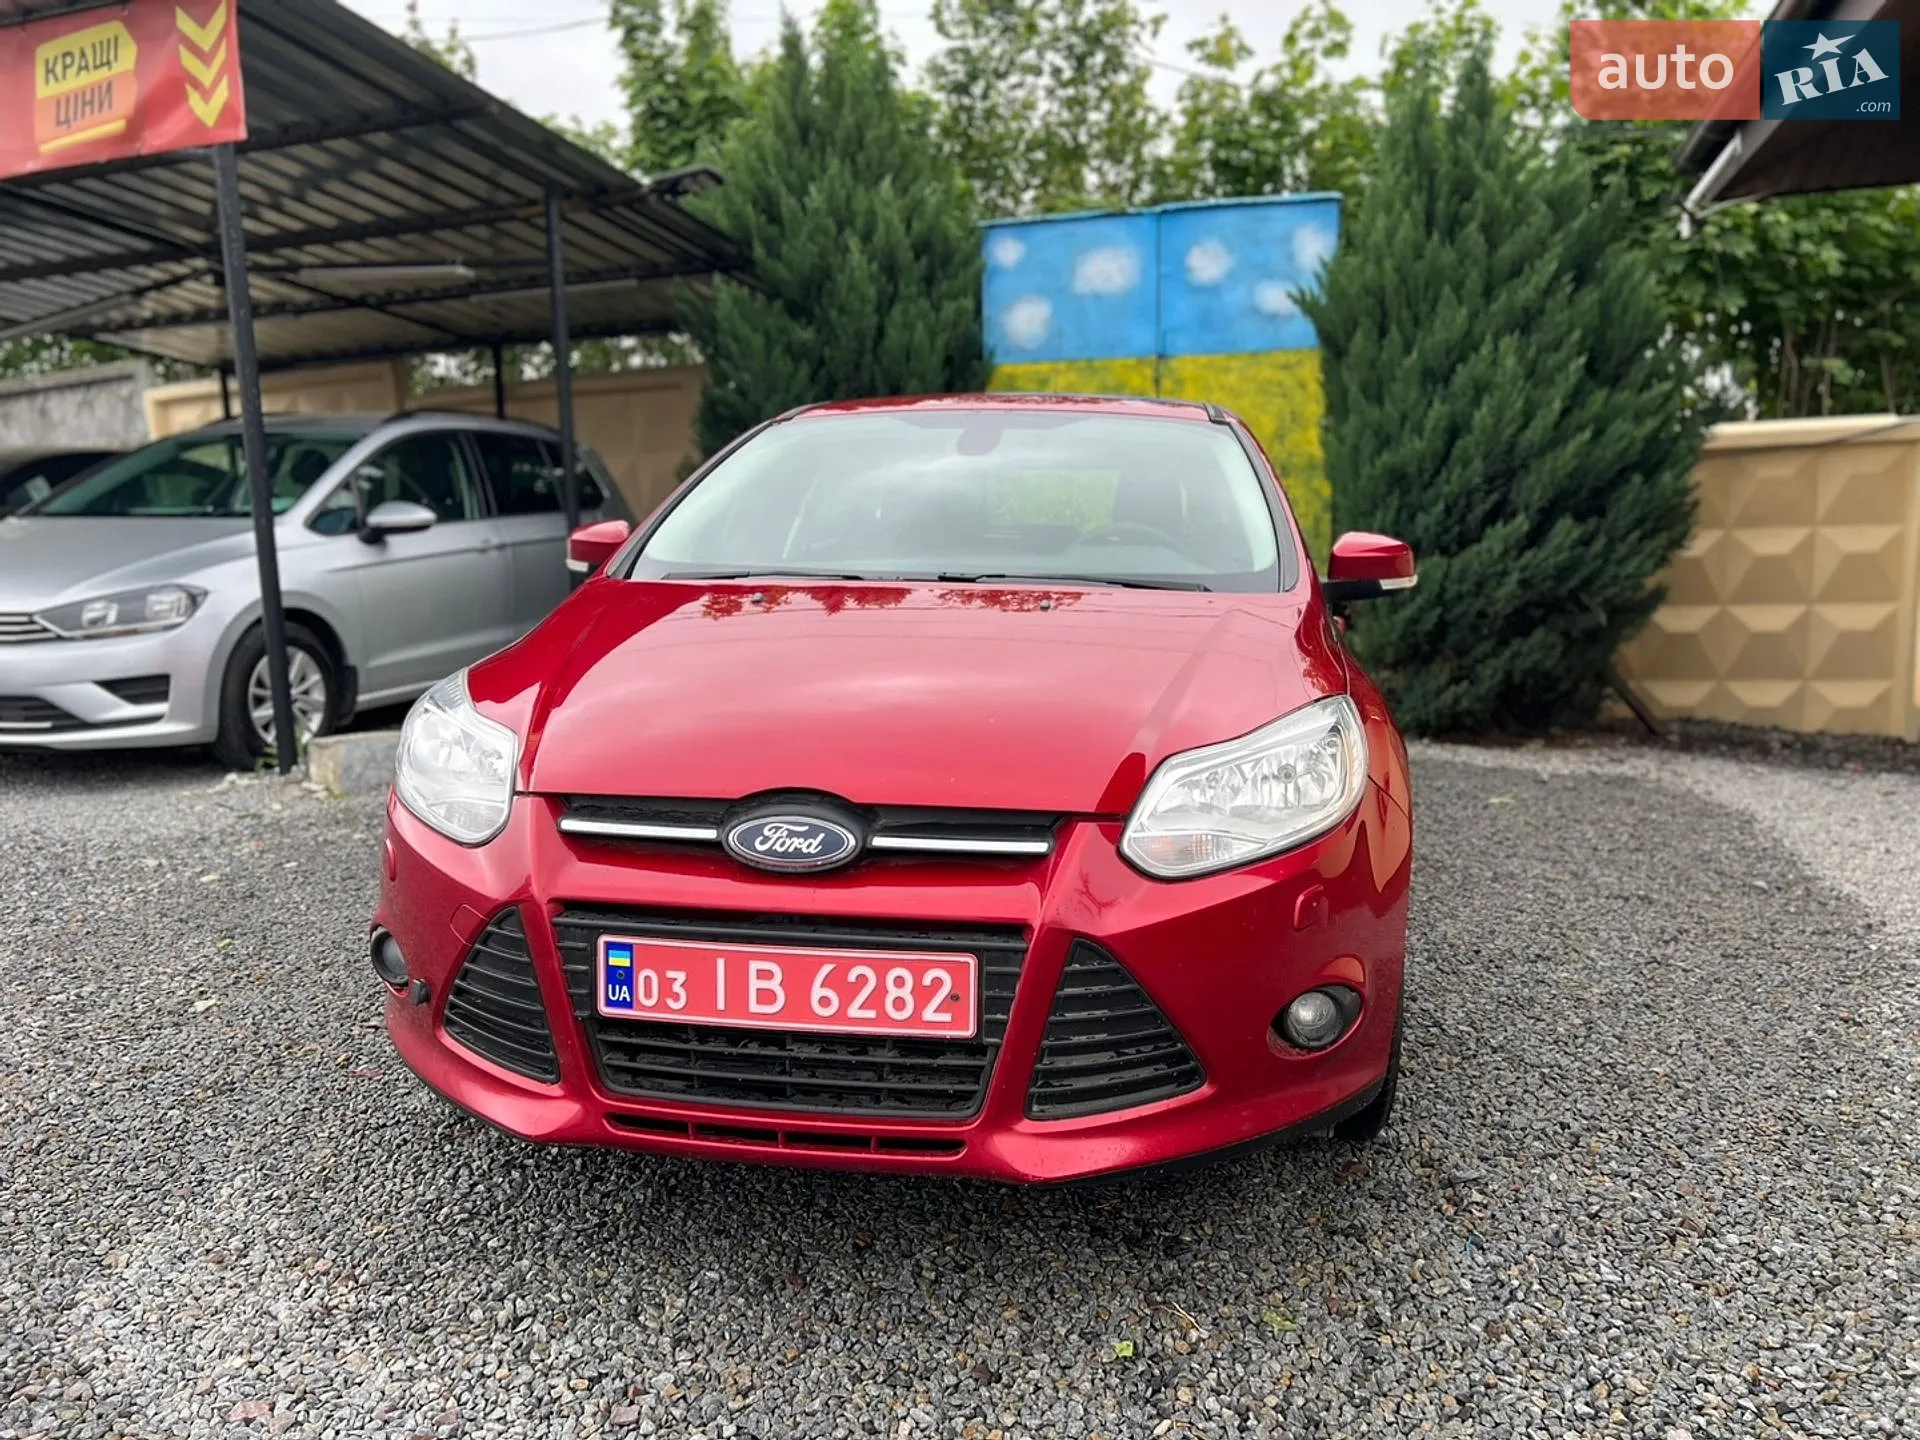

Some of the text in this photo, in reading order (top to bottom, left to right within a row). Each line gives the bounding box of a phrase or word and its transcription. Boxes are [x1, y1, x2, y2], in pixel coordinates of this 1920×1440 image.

[44, 35, 119, 85] КРАЩІ
[54, 80, 113, 129] ЦІНИ
[754, 823, 825, 854] Ford
[608, 984, 631, 1003] UA
[637, 957, 954, 1023] 03 IB 6282
